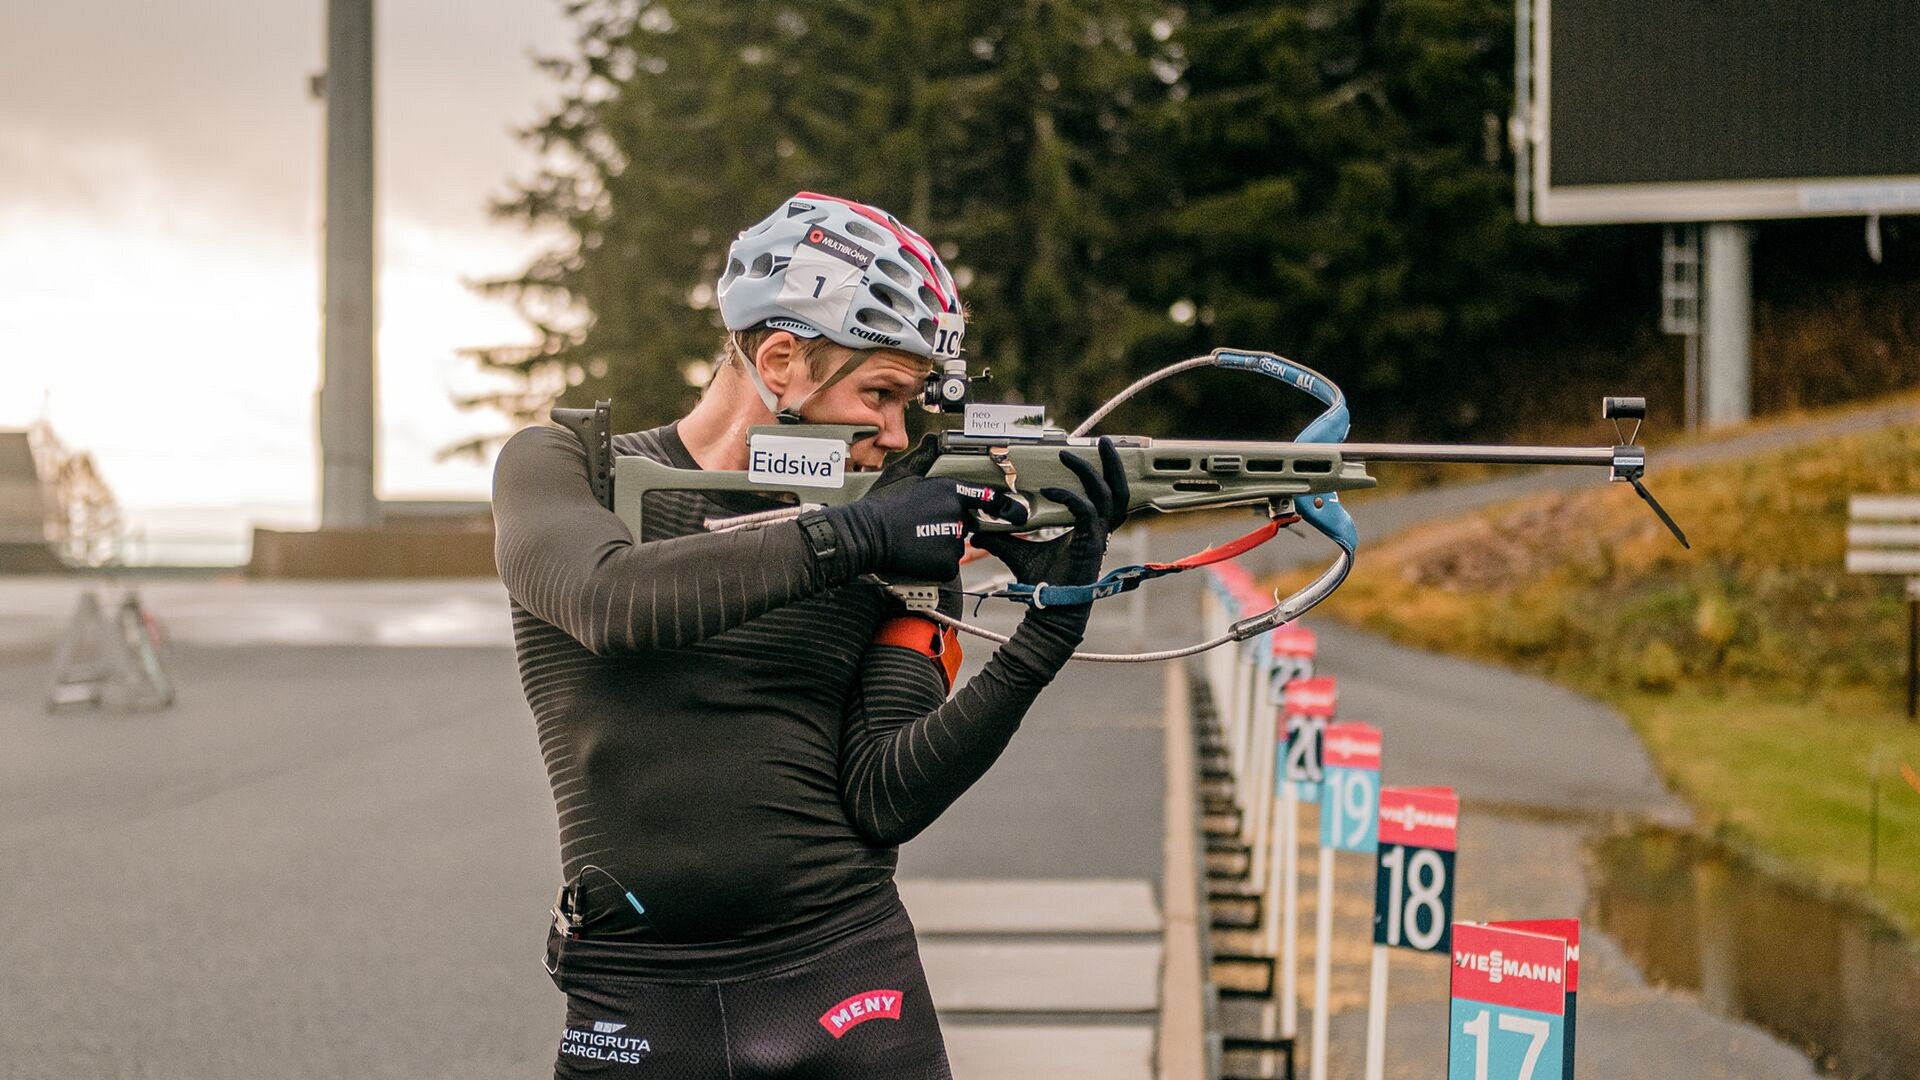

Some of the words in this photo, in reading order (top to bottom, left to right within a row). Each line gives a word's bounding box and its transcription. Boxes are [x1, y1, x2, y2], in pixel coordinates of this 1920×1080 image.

[821, 236, 869, 264] MULTIBLOKK
[811, 275, 827, 299] 1
[850, 326, 902, 347] catlike
[972, 411, 991, 419] neo
[972, 419, 1000, 429] hytter
[753, 451, 832, 477] Eidsiva
[1327, 770, 1375, 850] 19
[1381, 845, 1446, 951] 18
[1455, 950, 1562, 984] VIESSMANN
[830, 996, 896, 1029] MENY
[561, 1042, 640, 1064] CARGLASS
